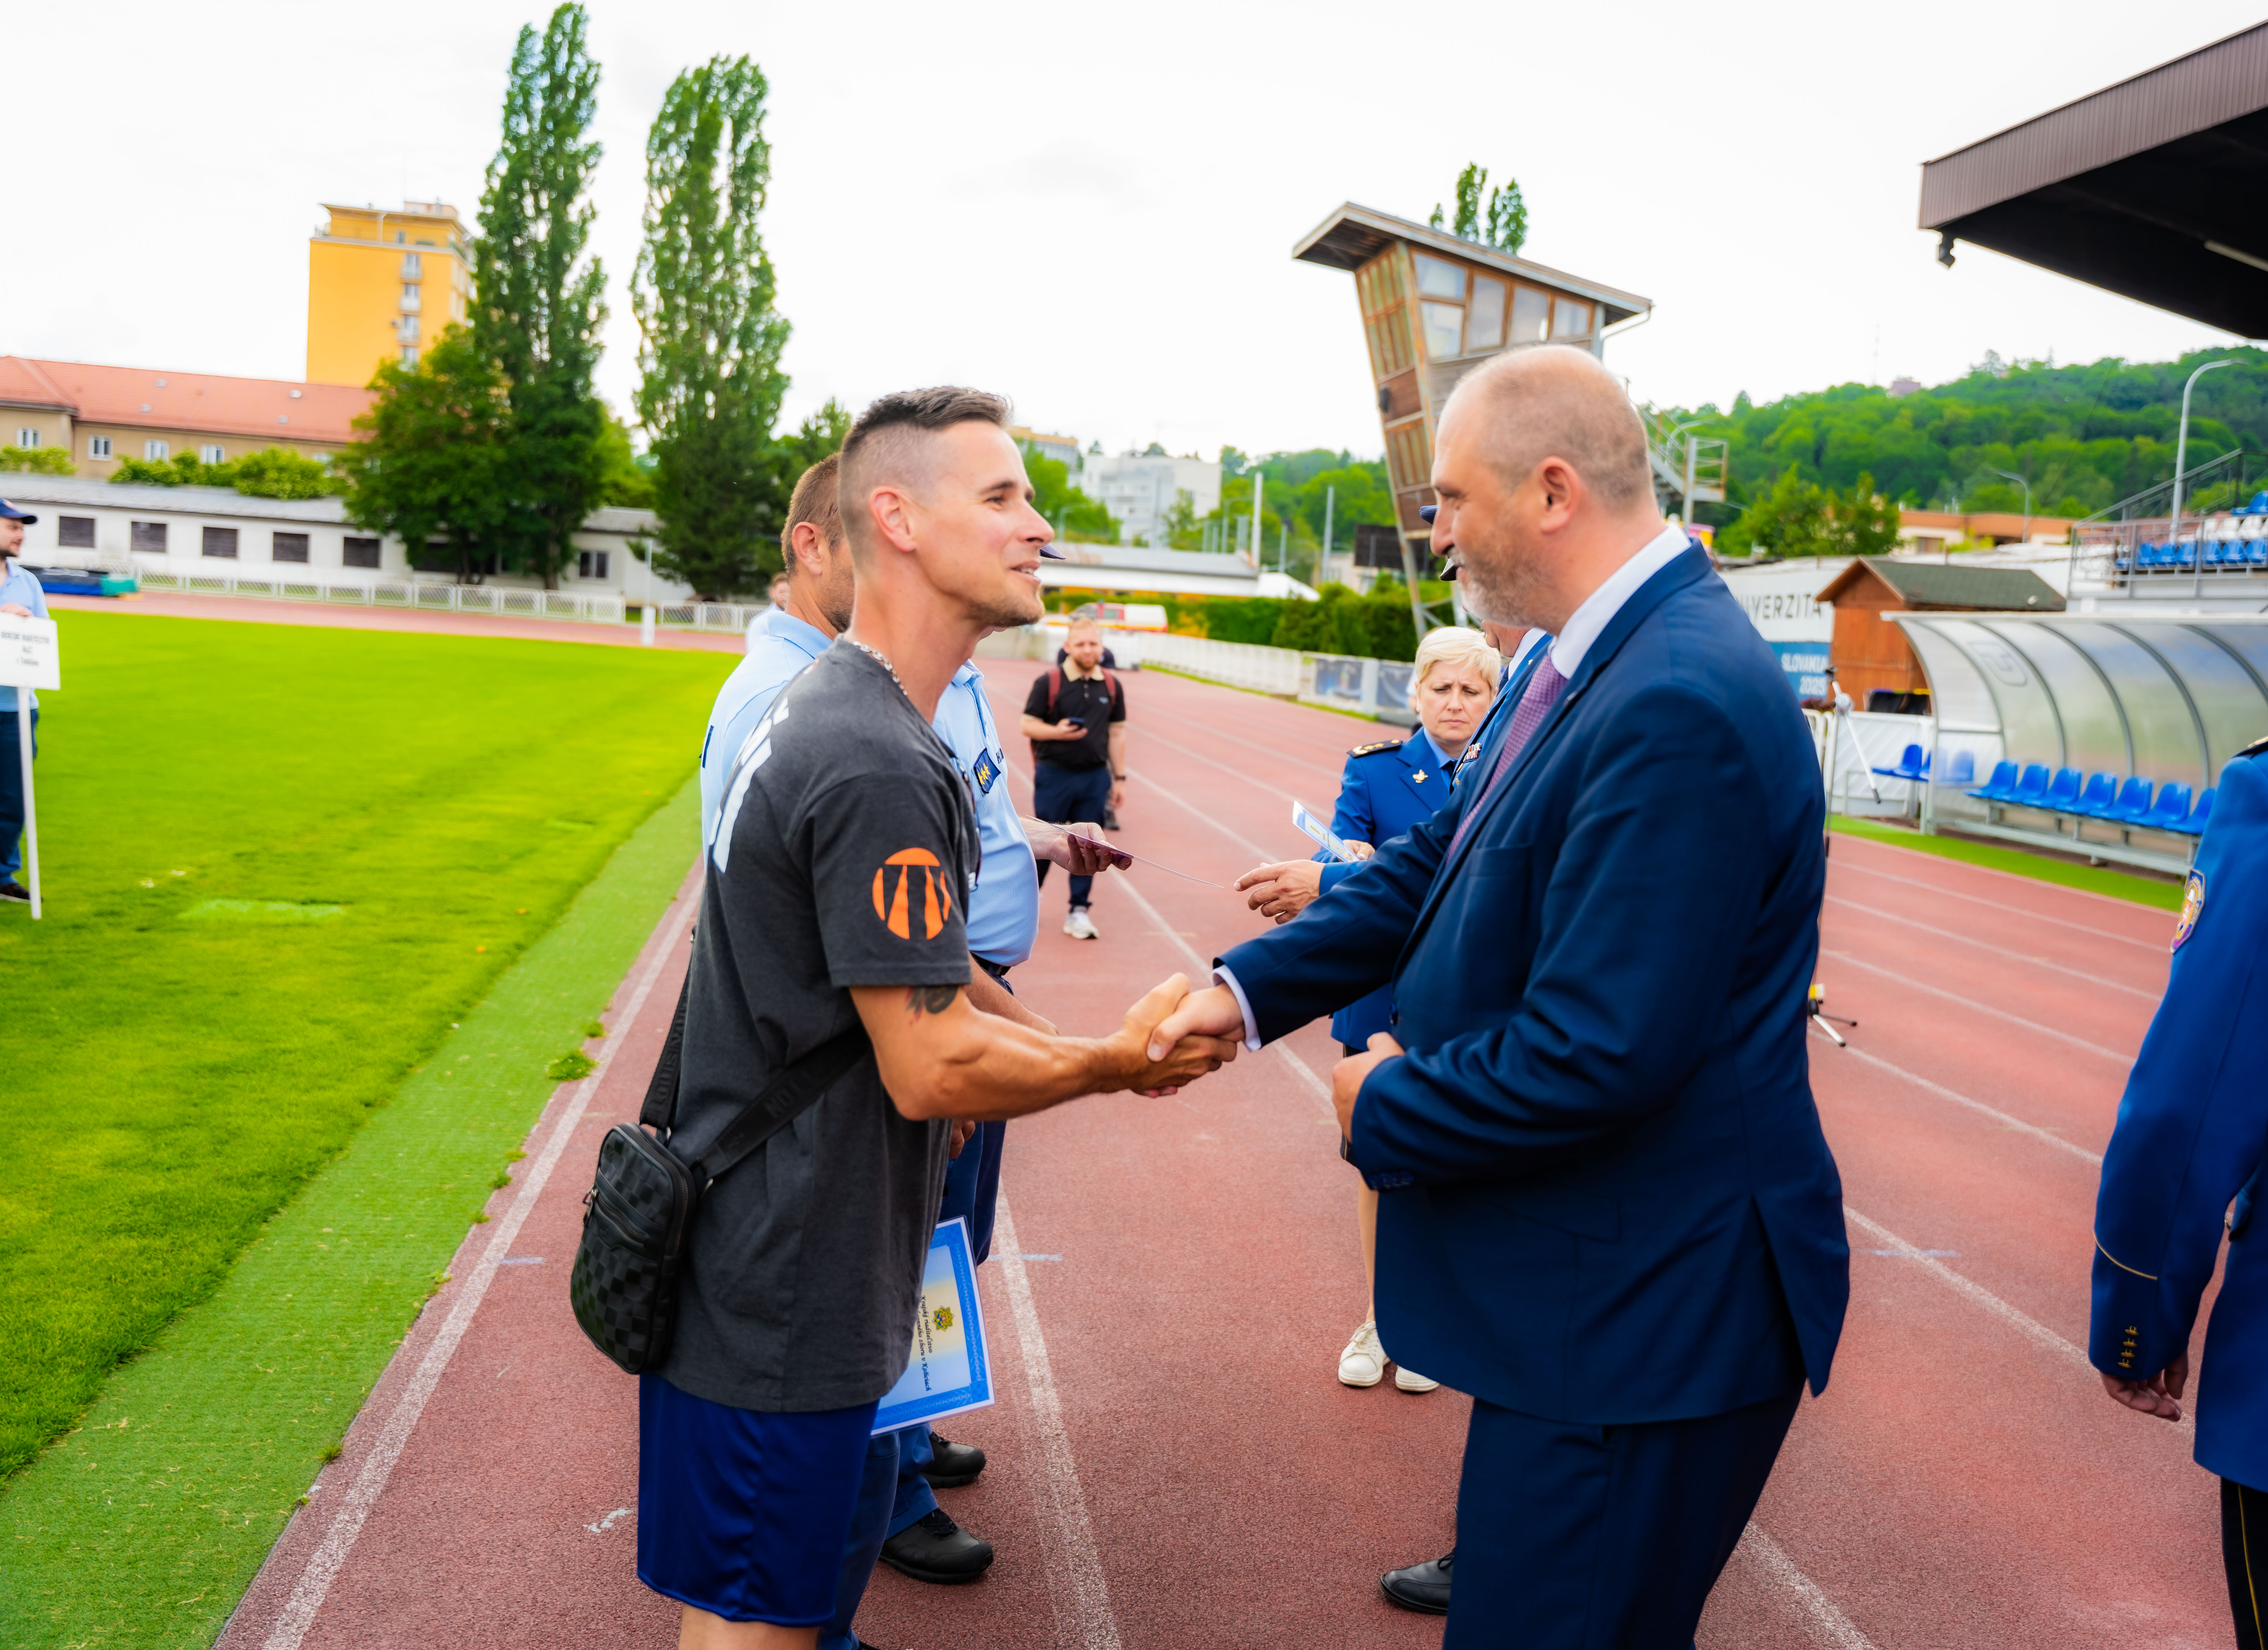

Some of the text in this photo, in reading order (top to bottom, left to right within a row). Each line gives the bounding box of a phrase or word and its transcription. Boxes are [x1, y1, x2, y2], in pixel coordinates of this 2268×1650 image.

[1781, 653, 1828, 674] SLOVAKIA
[1799, 675, 1827, 696] 2025
[924, 1319, 933, 1353] riaditeľstvo
[922, 1362, 931, 1391] Košiciach
